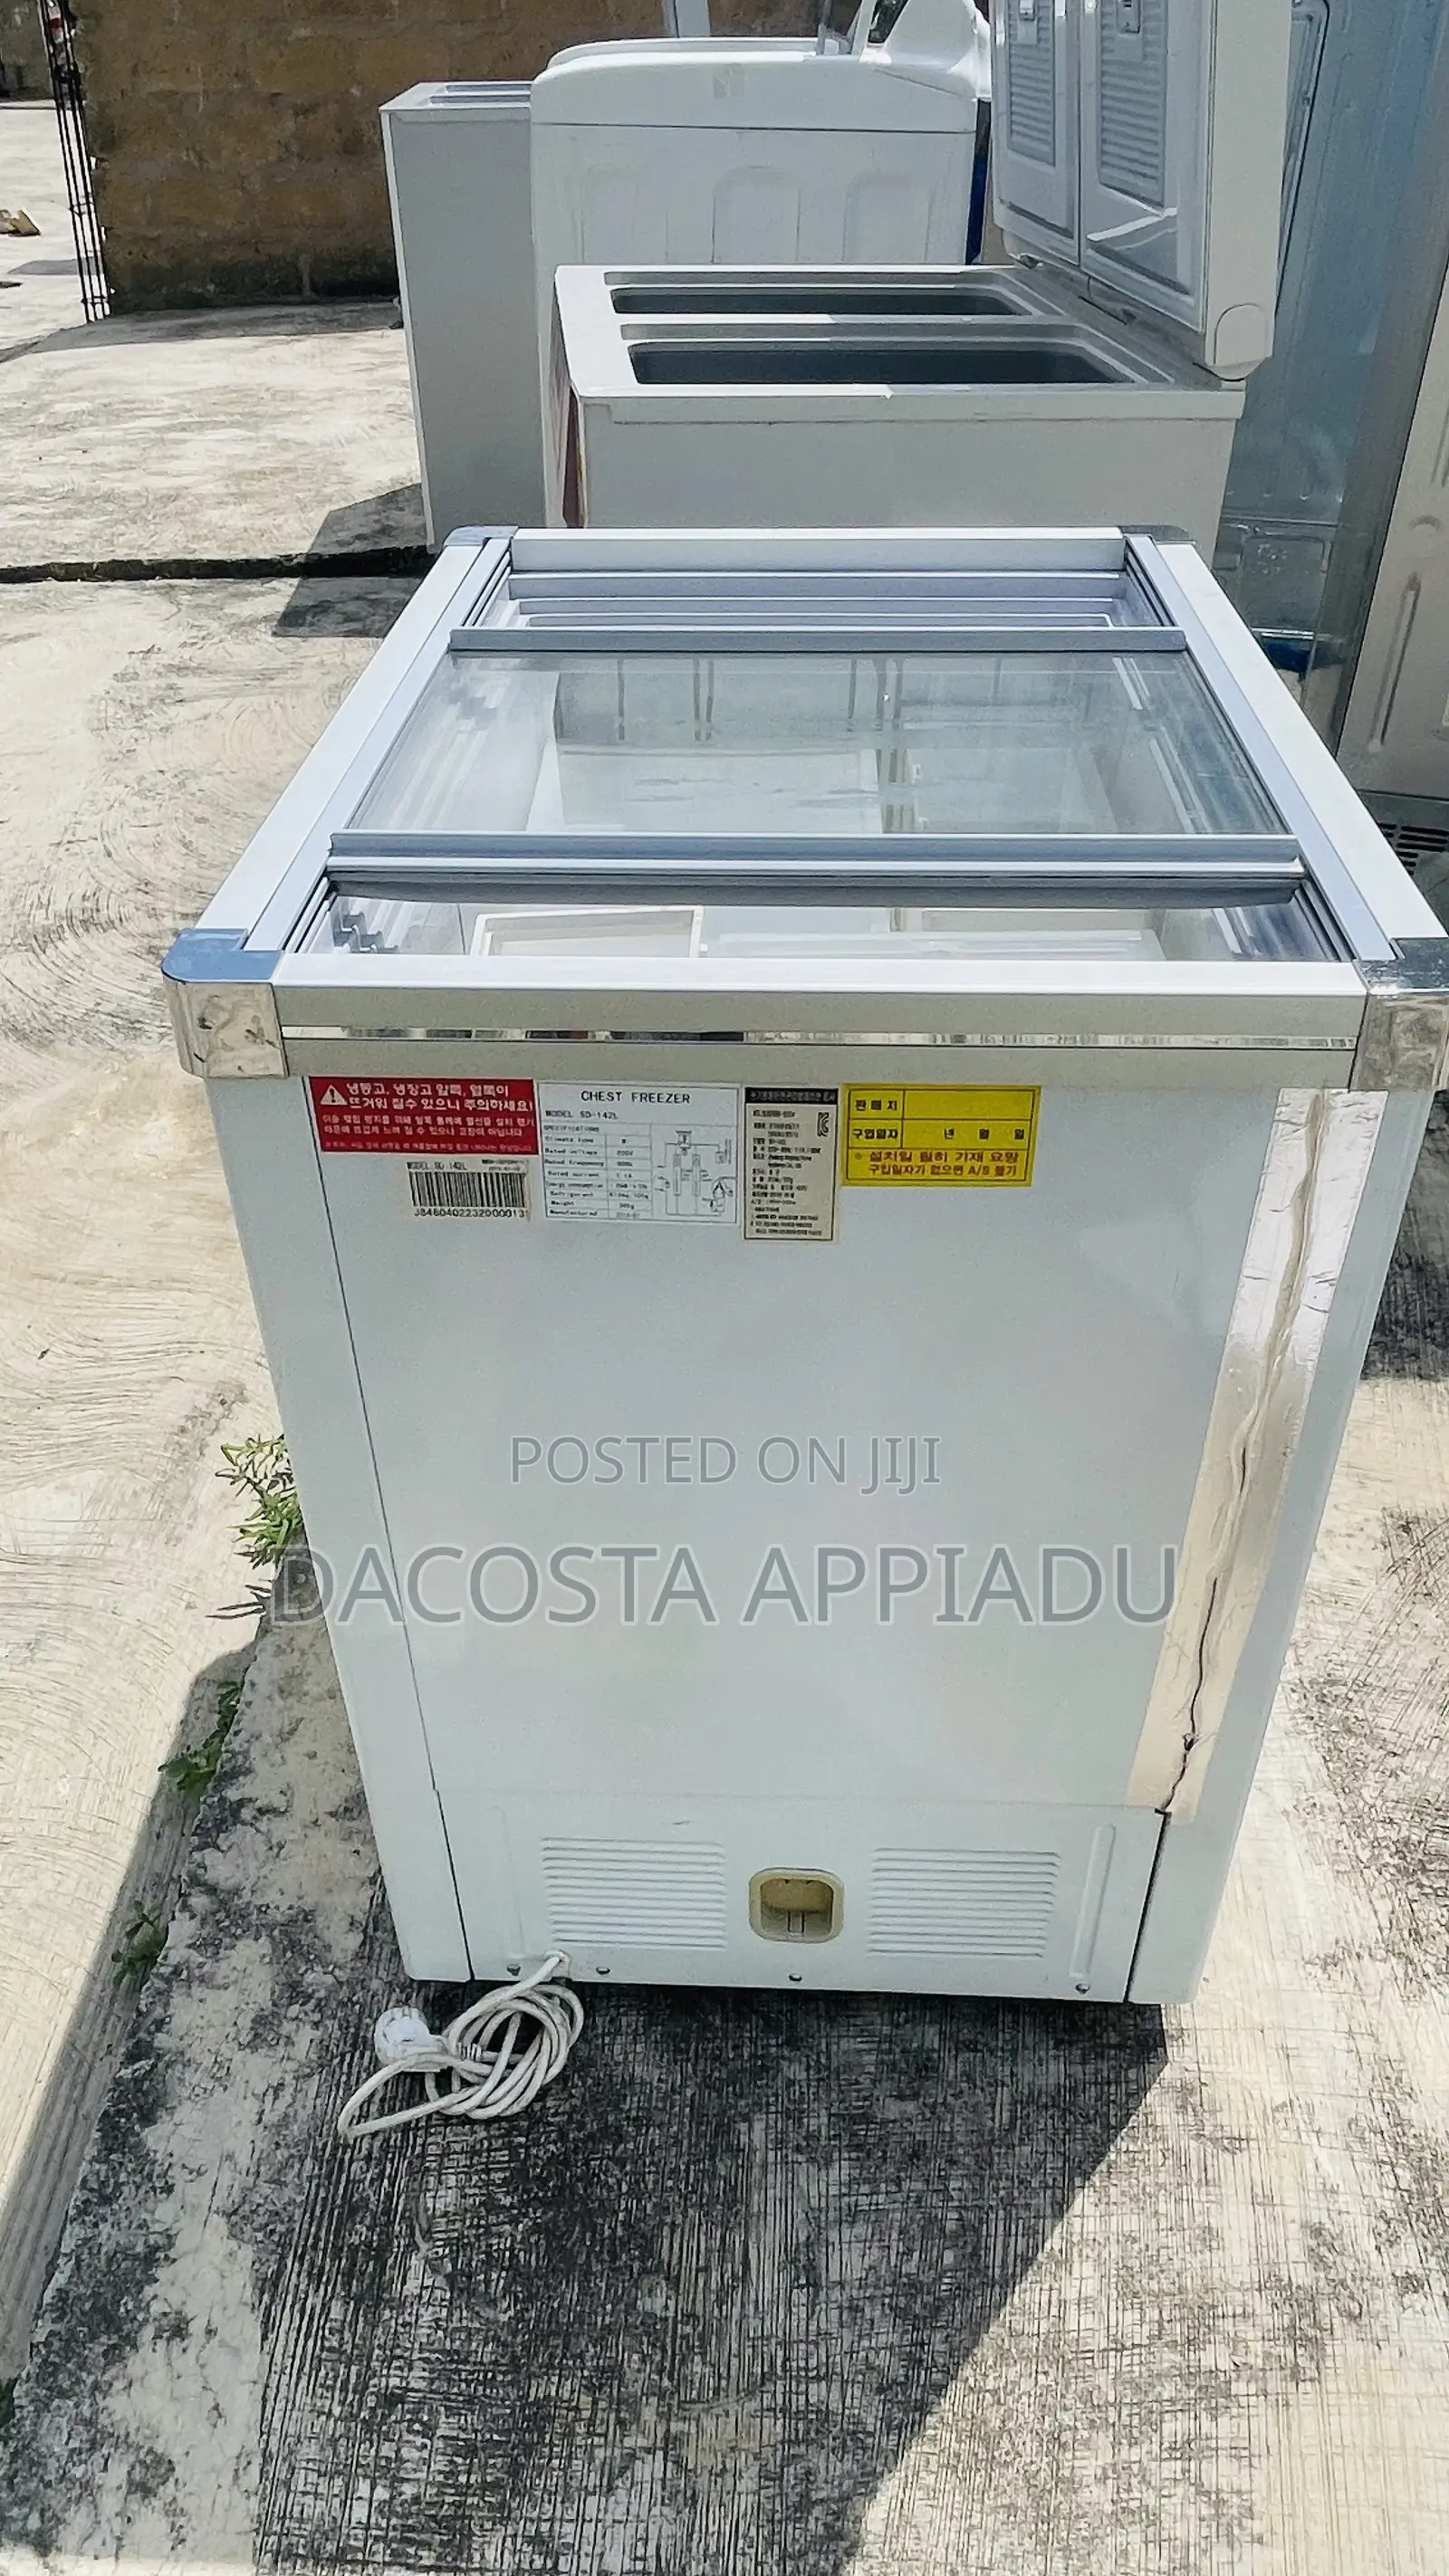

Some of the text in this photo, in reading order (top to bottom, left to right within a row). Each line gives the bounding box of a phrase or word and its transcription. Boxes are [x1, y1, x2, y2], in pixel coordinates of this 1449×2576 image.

[581, 1090, 692, 1105] CHEST FREEZER
[580, 1110, 619, 1120] SD-142L
[967, 1164, 990, 1176] A/S
